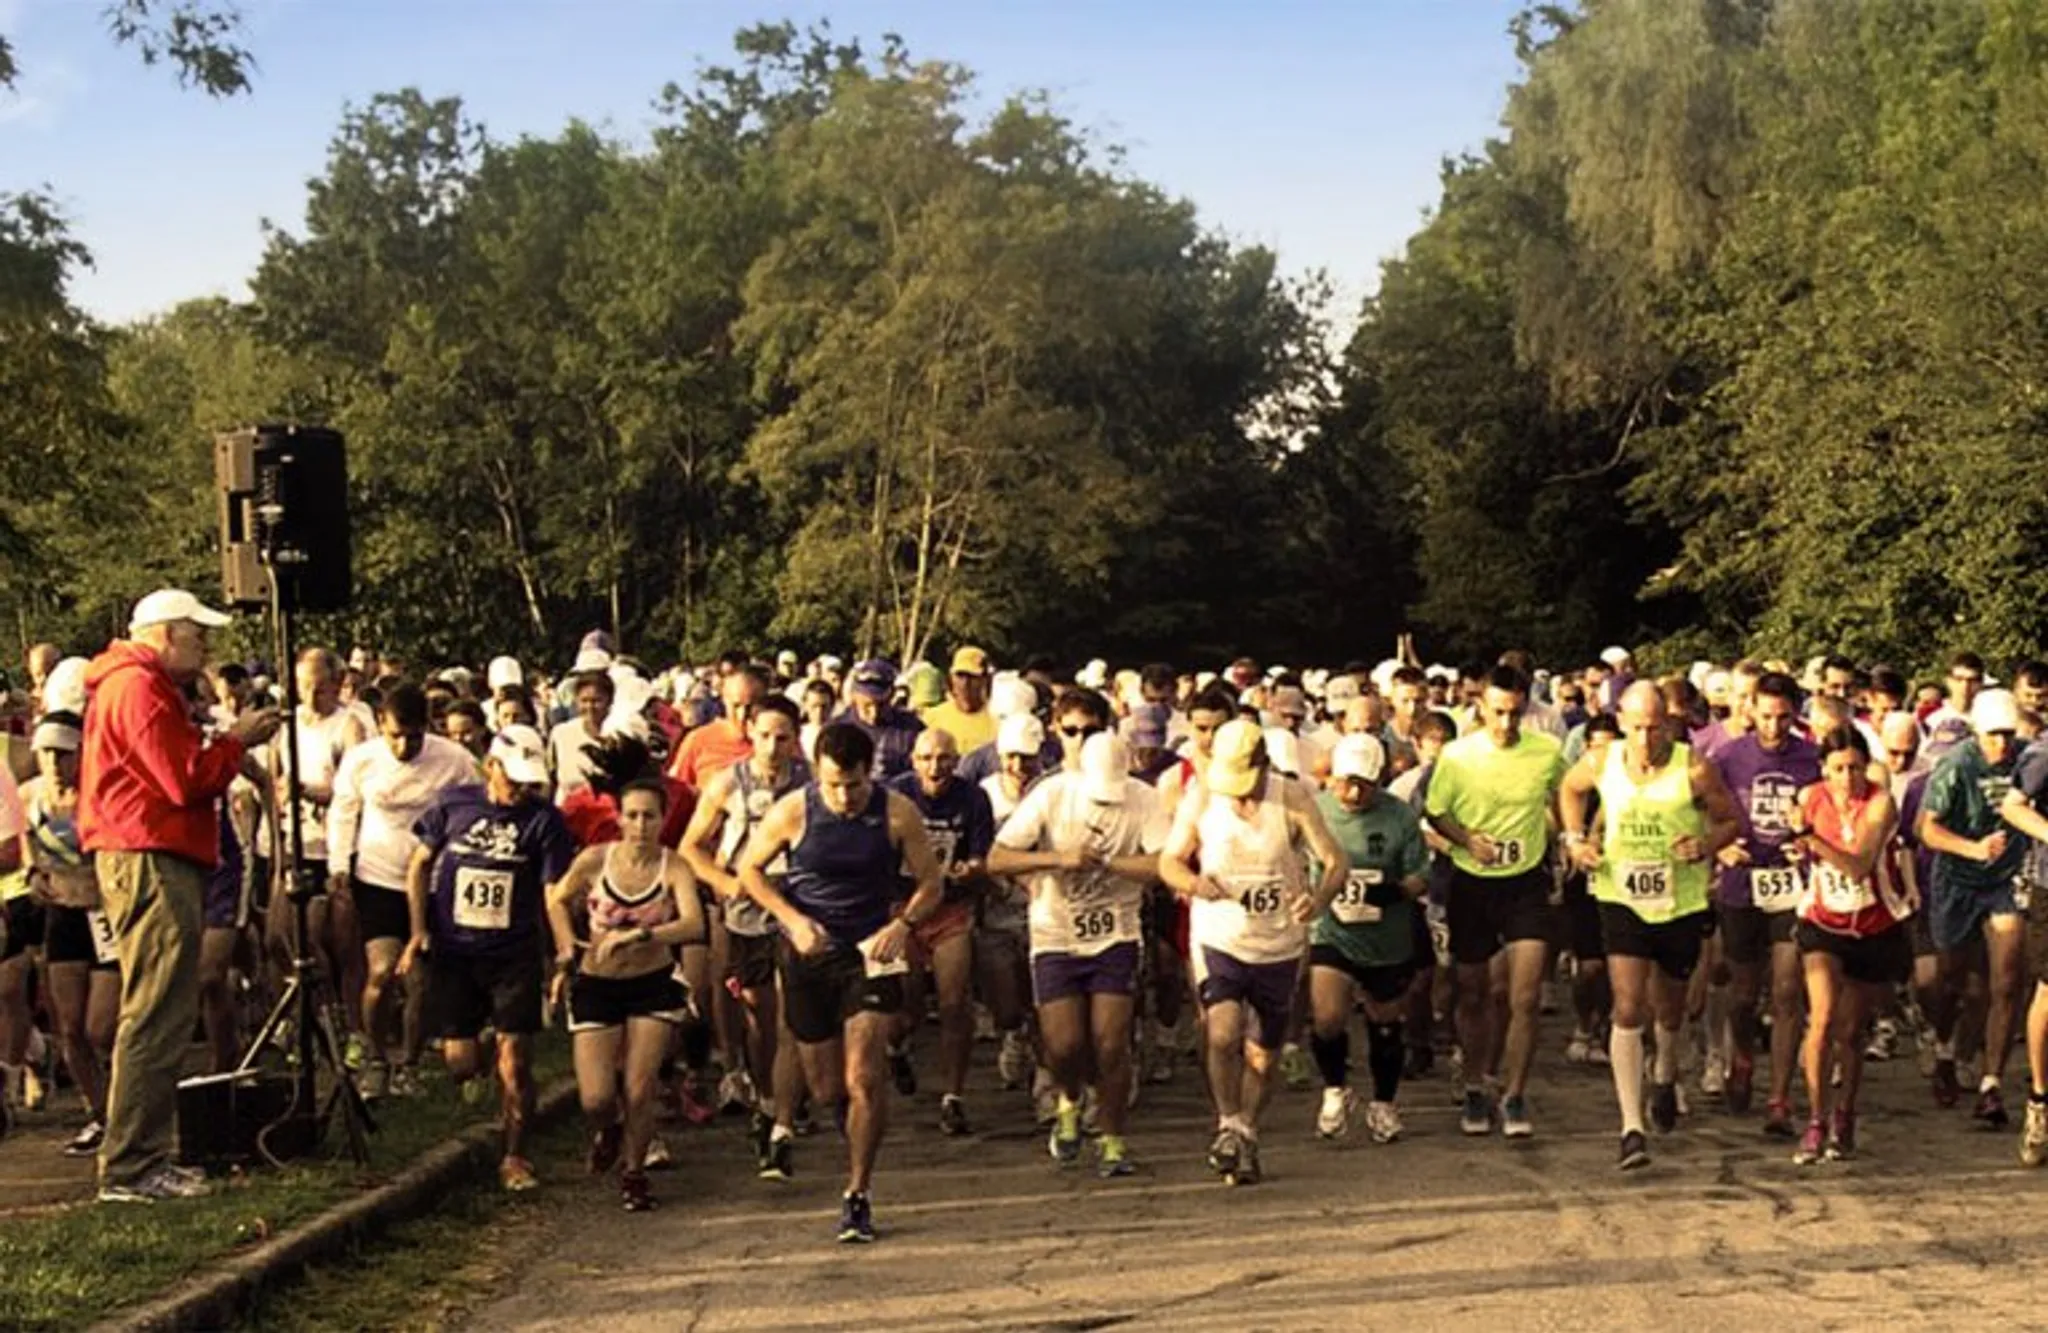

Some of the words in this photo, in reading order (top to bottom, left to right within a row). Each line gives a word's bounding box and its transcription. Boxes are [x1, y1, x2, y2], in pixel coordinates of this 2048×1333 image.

[463, 881, 505, 908] 438
[1625, 871, 1667, 895] 406
[1757, 872, 1794, 897] 653
[1240, 887, 1281, 914] 465
[1073, 911, 1115, 939] 569
